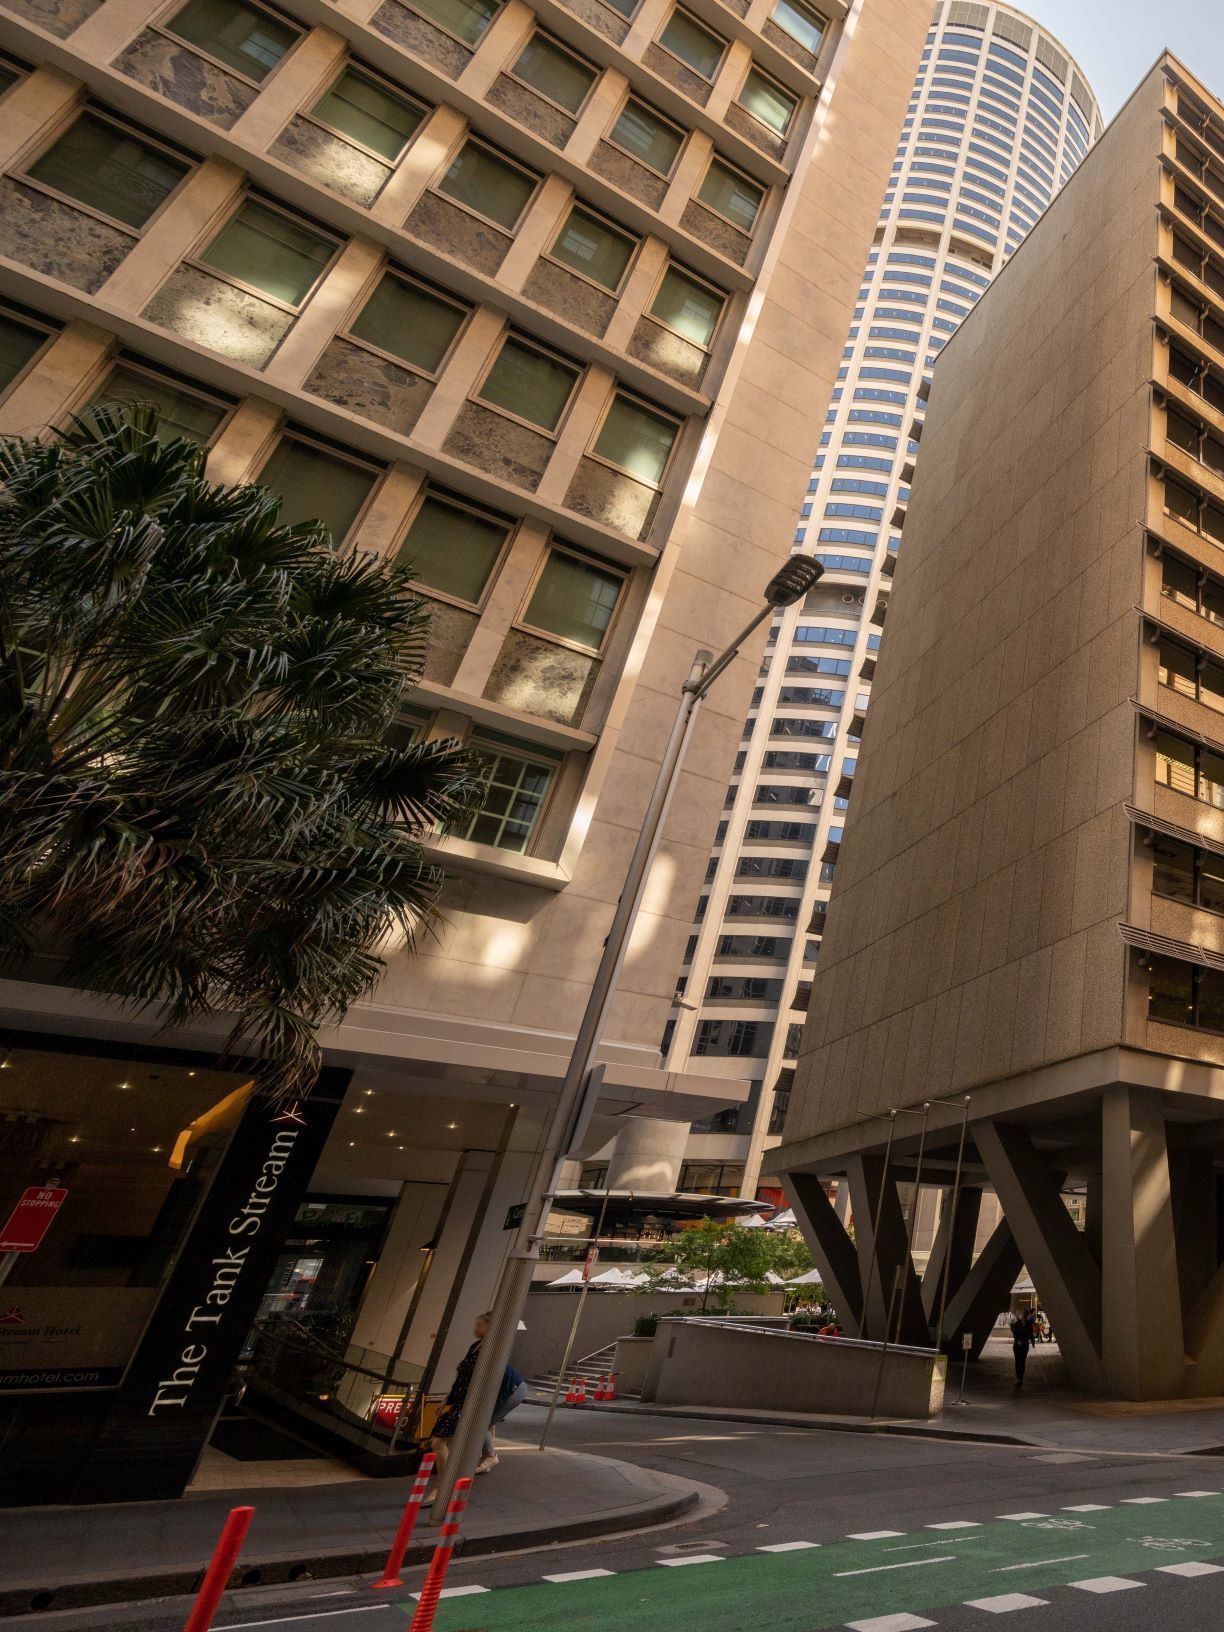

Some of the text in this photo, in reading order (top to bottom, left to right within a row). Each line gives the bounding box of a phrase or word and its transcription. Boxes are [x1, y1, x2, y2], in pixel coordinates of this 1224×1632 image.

[36, 1191, 53, 1200] NO
[21, 1200, 60, 1208] STOPPING
[148, 1130, 299, 1416] The Tank Stream
[0, 1326, 81, 1337] tream Hotel
